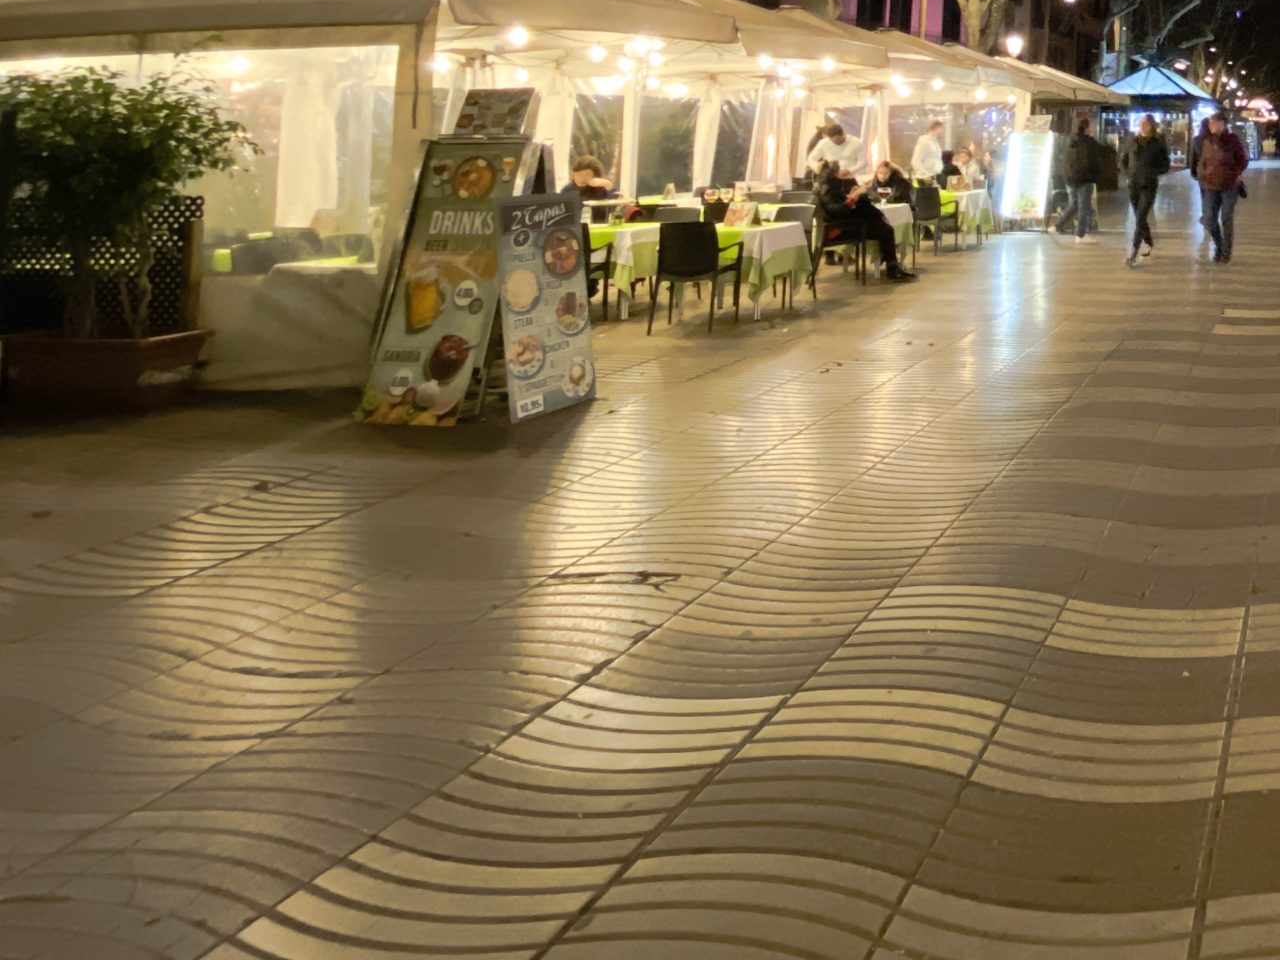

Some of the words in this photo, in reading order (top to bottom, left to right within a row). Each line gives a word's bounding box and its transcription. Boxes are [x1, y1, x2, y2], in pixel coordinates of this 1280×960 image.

[428, 210, 494, 236] DRINKS
[511, 211, 522, 230] 2
[523, 203, 566, 230] Tapas
